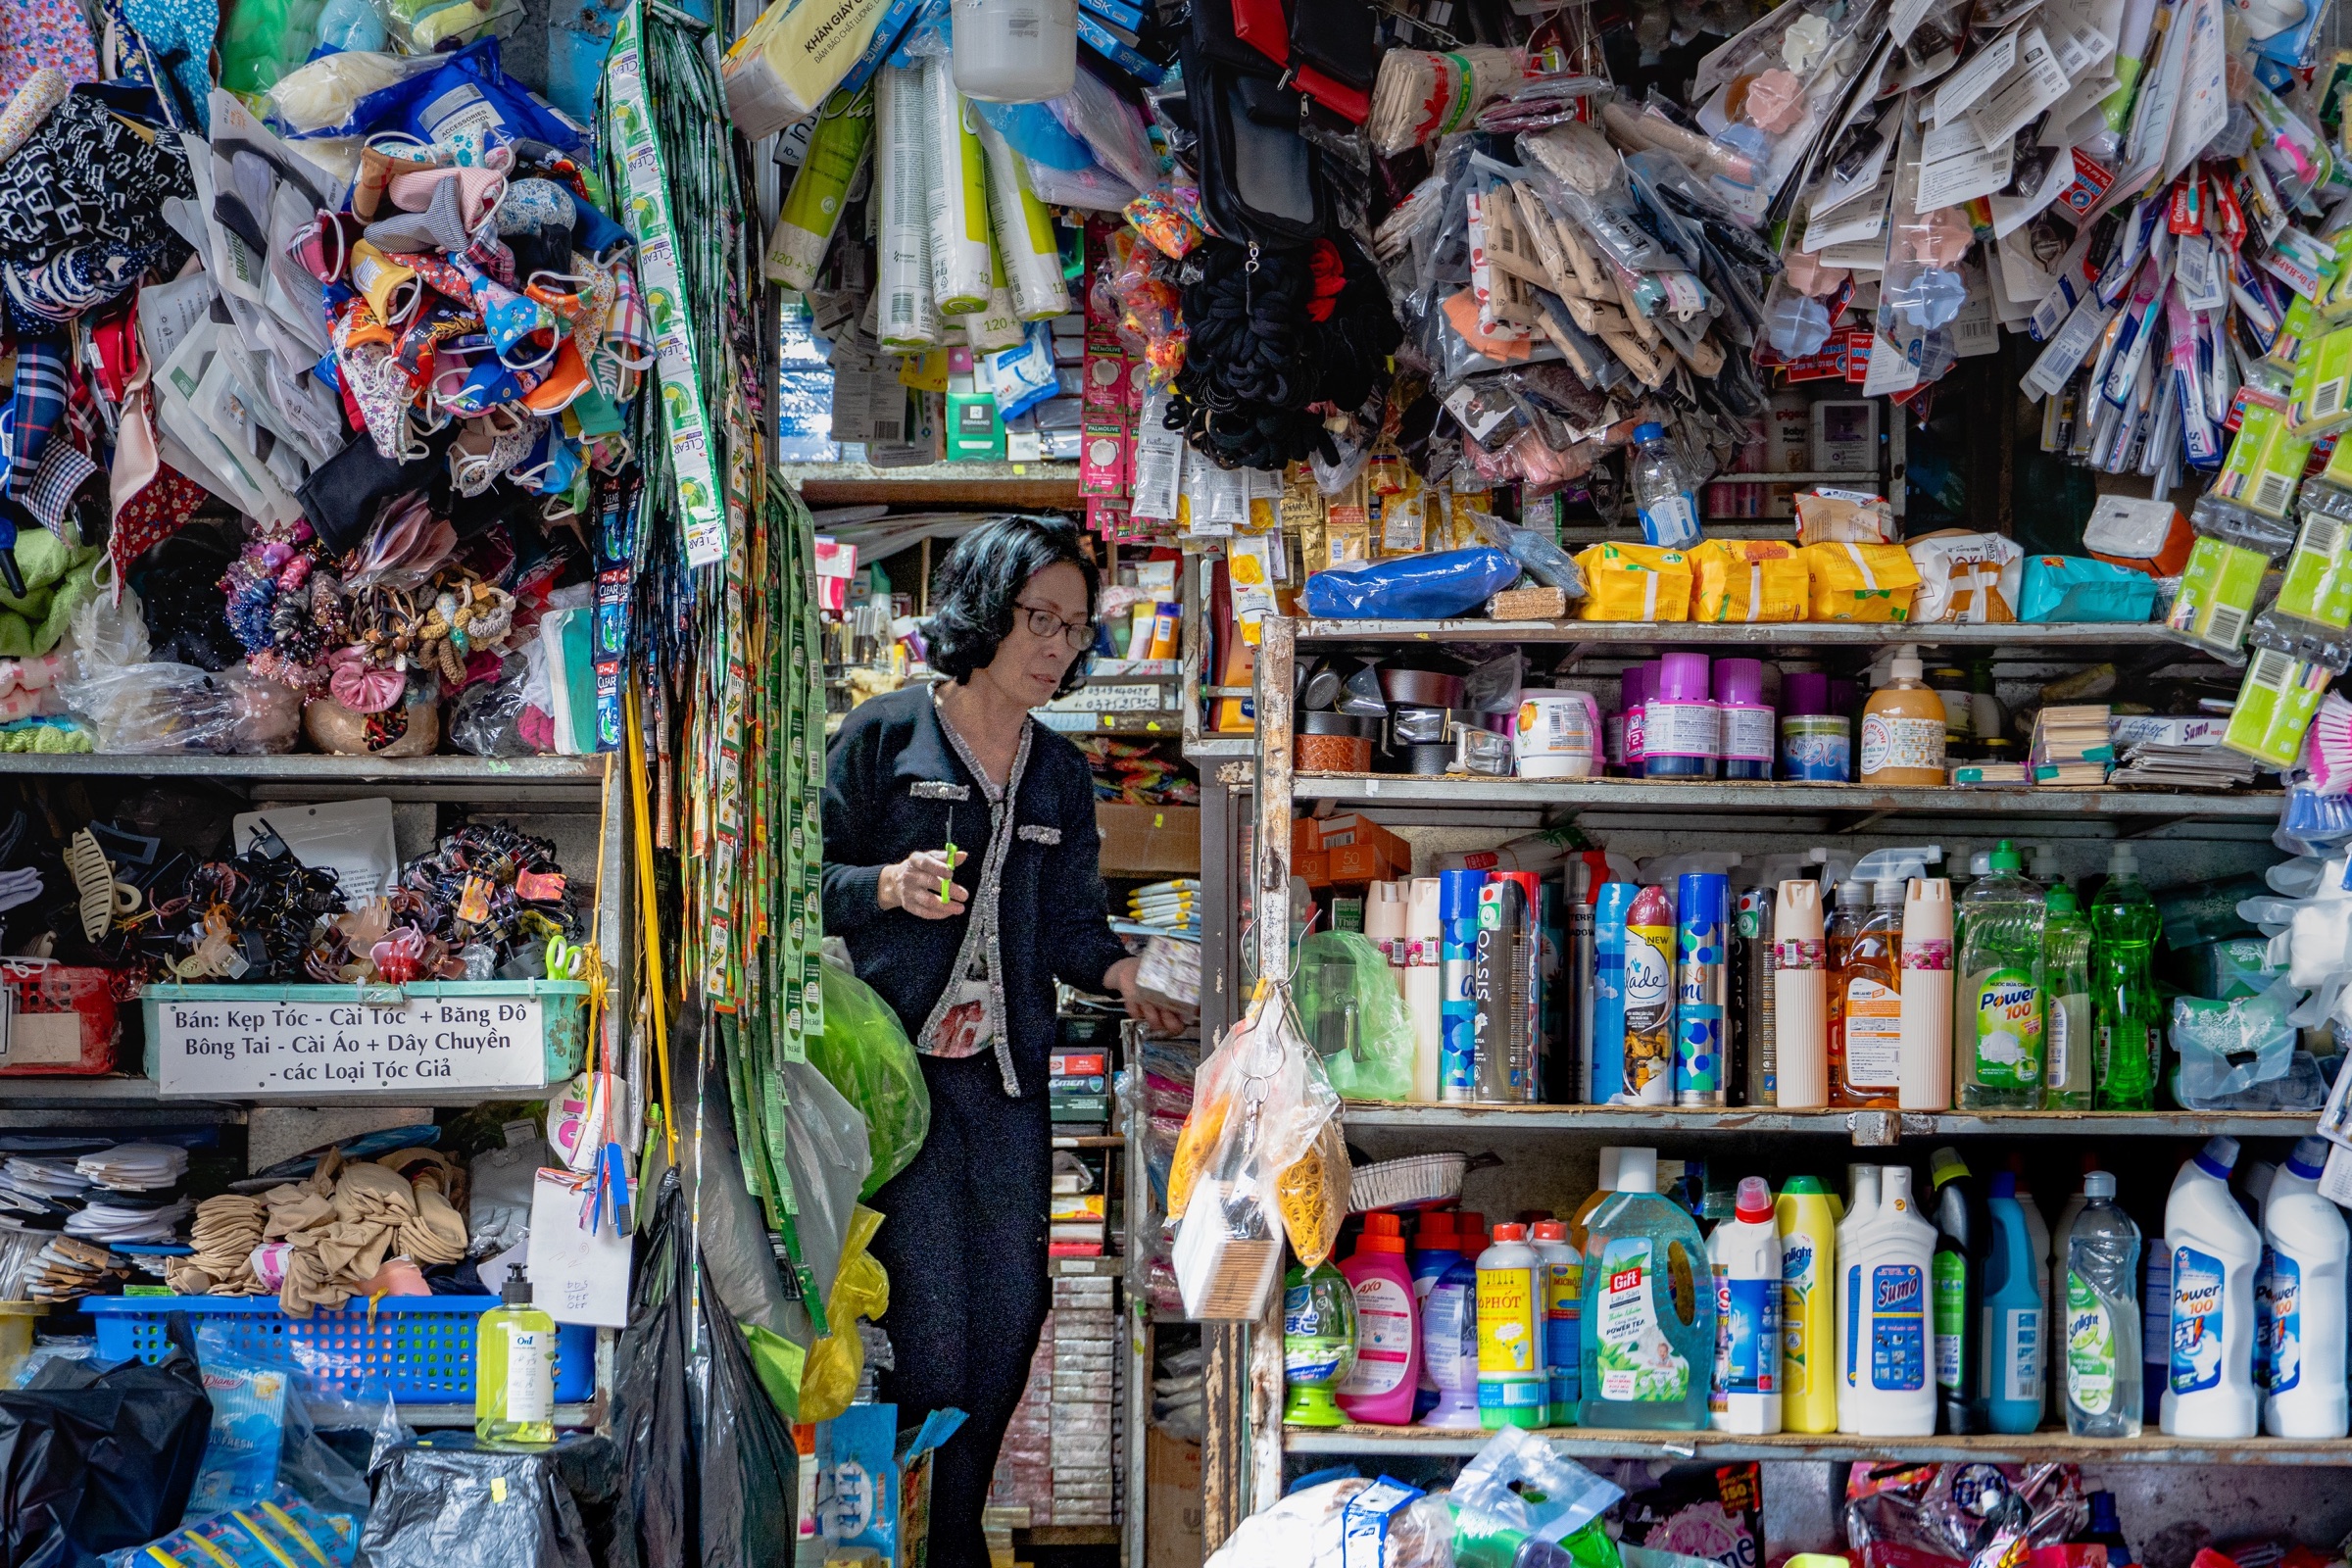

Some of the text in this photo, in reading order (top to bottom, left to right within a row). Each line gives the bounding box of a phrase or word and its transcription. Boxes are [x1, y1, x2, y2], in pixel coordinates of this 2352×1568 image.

[1087, 0, 1112, 14] ASK
[804, 1, 855, 53] KHĂN GIẤY
[871, 28, 891, 53] MASK
[441, 110, 488, 138] ACCESSORIES
[627, 153, 657, 172] CLEAR
[2075, 172, 2103, 196] MINH
[2173, 189, 2187, 223] Colgate
[642, 246, 673, 266] CLEAR
[770, 249, 793, 269] 120
[804, 263, 816, 278] 30
[983, 317, 1008, 333] 120
[1090, 345, 1122, 354] PALMOLIVE
[1823, 343, 1846, 355] INH
[1088, 424, 1120, 433] PALMOLIVE
[673, 437, 706, 456] CLEAR
[599, 584, 618, 597] CLEAR
[597, 675, 617, 687] CLEAR
[2183, 721, 2209, 743] Sumo
[1300, 859, 1318, 874] 50
[1343, 851, 1360, 865] 50
[1646, 935, 1670, 946] NEW
[1625, 967, 1669, 990] lade
[1677, 983, 1705, 1002] mi
[1980, 987, 2037, 1011] Power
[175, 1010, 220, 1029] Bán:
[227, 1010, 266, 1033] Kẹp
[271, 1008, 309, 1028] Tóc
[329, 1007, 363, 1026] Cài
[369, 1007, 406, 1025] Tóc
[441, 1005, 491, 1028] Băng
[2004, 1002, 2032, 1021] 100
[185, 1037, 235, 1060] Bông
[241, 1036, 270, 1054] Tai
[292, 1035, 324, 1054] Cài
[332, 1030, 360, 1053] Áo
[387, 1034, 428, 1055] Dây
[435, 1027, 511, 1054] Chuyền
[283, 1062, 318, 1080] các
[324, 1061, 365, 1083] Loại
[372, 1060, 409, 1078] Tóc
[416, 1057, 451, 1078] Giả
[1783, 1246, 1813, 1265] nlight
[1357, 1280, 1383, 1295] AXO
[1613, 1271, 1638, 1291] Gift
[1611, 1293, 1625, 1303] Lau
[1877, 1276, 1919, 1308] Sumo
[2173, 1285, 2221, 1305] Power
[2189, 1299, 2214, 1315] 100
[2275, 1299, 2292, 1315] 100
[1606, 1319, 1645, 1336] POWER TEA
[2068, 1312, 2099, 1343] Sunlight
[516, 1335, 535, 1347] On1
[203, 1373, 236, 1388] Diana
[221, 1437, 255, 1450] FRESH
